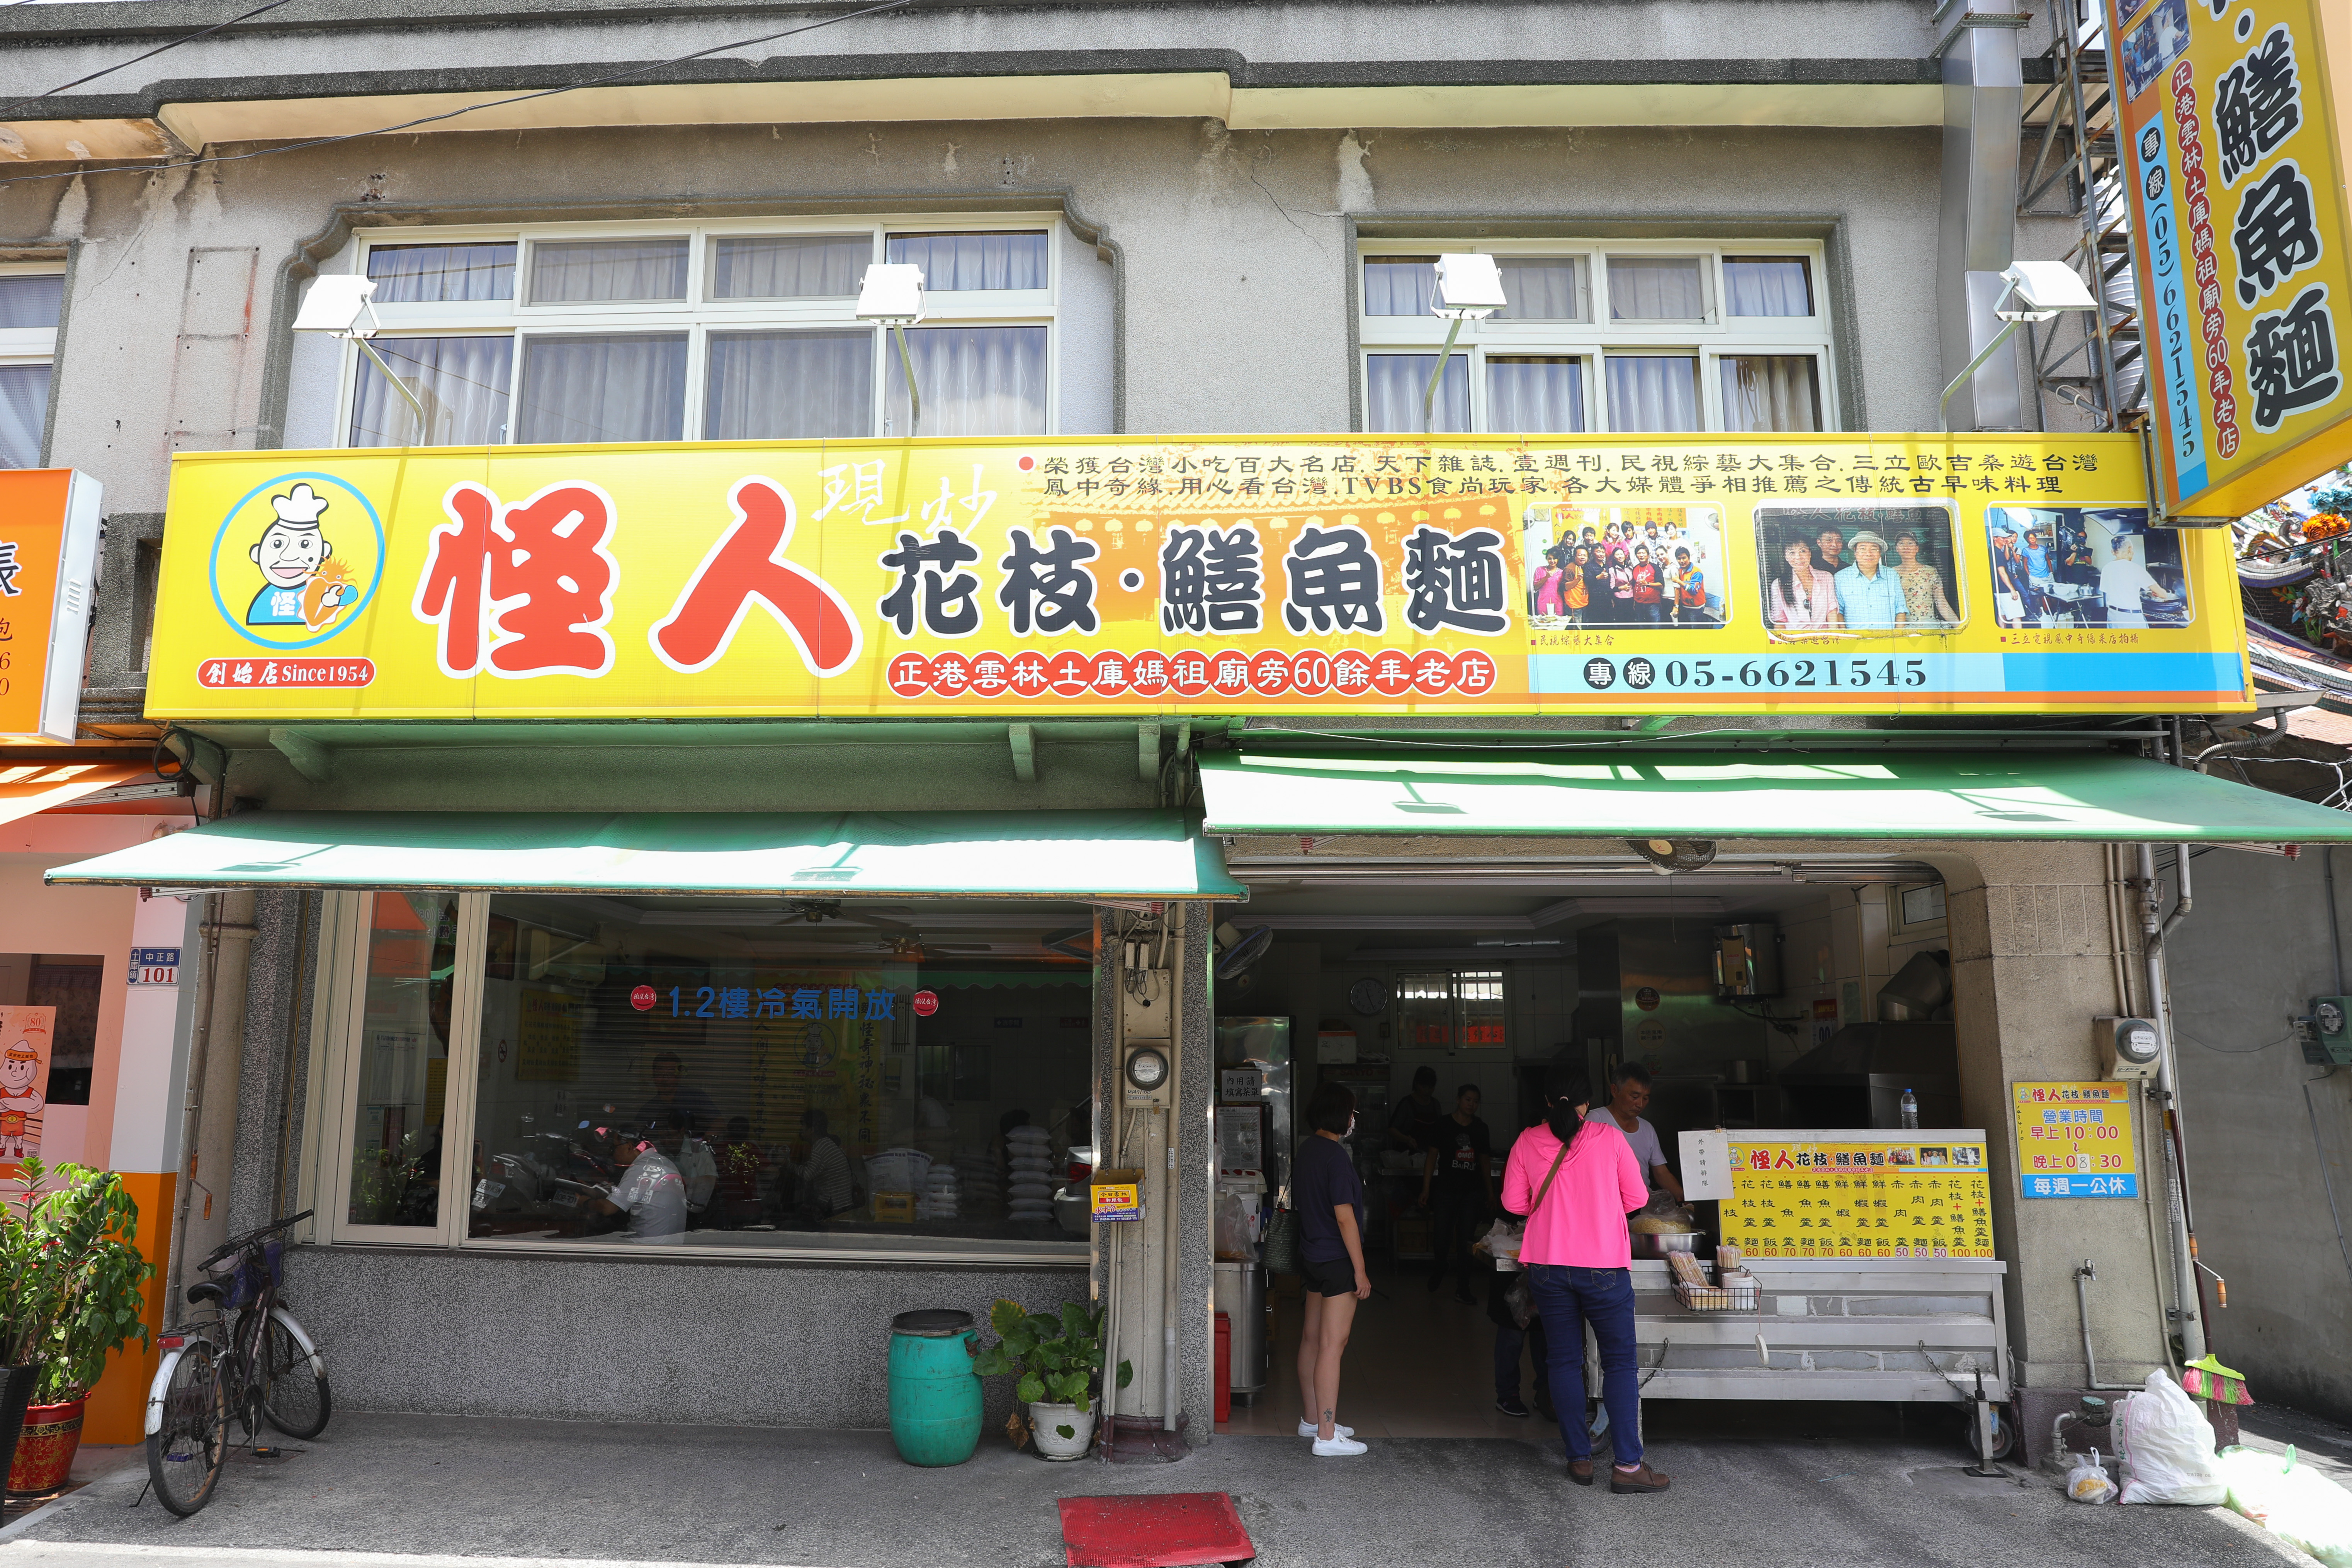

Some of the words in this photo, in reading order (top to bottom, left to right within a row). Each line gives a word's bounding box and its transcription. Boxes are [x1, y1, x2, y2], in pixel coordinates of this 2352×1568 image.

[2142, 130, 2165, 198] 專線
[2213, 0, 2338, 427] ·鱔魚麵
[2175, 63, 2237, 455] 正港雲林土庫媽祖廟旁60年老店
[2151, 203, 2195, 457] (05)6621545
[419, 481, 855, 672] 怪人
[270, 591, 295, 617] 怪
[1540, 634, 1614, 646] 民視綜藝大集合
[893, 657, 1493, 688] 正港雲林土庫媽祖廟旁60餘年老店
[1587, 660, 1652, 687] 專線
[1666, 659, 1927, 687] 05-6621545
[145, 952, 174, 962] 中正路
[129, 952, 139, 980] 土庫鎮
[143, 967, 173, 982] 101
[669, 985, 896, 1021] 1.2樓冷氣開放
[1227, 1076, 1255, 1086] 內用請
[1225, 1087, 1259, 1097] 填寫菜單
[2032, 1088, 2061, 1102] 怪人
[2043, 1109, 2103, 1124] 營業時間
[1698, 1139, 1709, 1187] 外帶請排隊
[1750, 1149, 1795, 1170] 怪人
[2034, 1177, 2126, 1195] 每週一公休
[1723, 1180, 1740, 1247] 枝羹
[1745, 1248, 1758, 1256] 60
[1764, 1248, 1778, 1256] 60
[1784, 1248, 1796, 1256] 70
[1802, 1248, 1815, 1256] 70
[1821, 1248, 1834, 1256] 70
[1839, 1248, 1852, 1257] 60
[1858, 1248, 1871, 1257] 60
[1877, 1248, 1890, 1257] 60
[1895, 1247, 1908, 1257] 50
[1915, 1247, 1928, 1257] 50
[1934, 1248, 1947, 1257] 50
[1951, 1248, 1970, 1257] 100
[1973, 1248, 1993, 1257] 100
